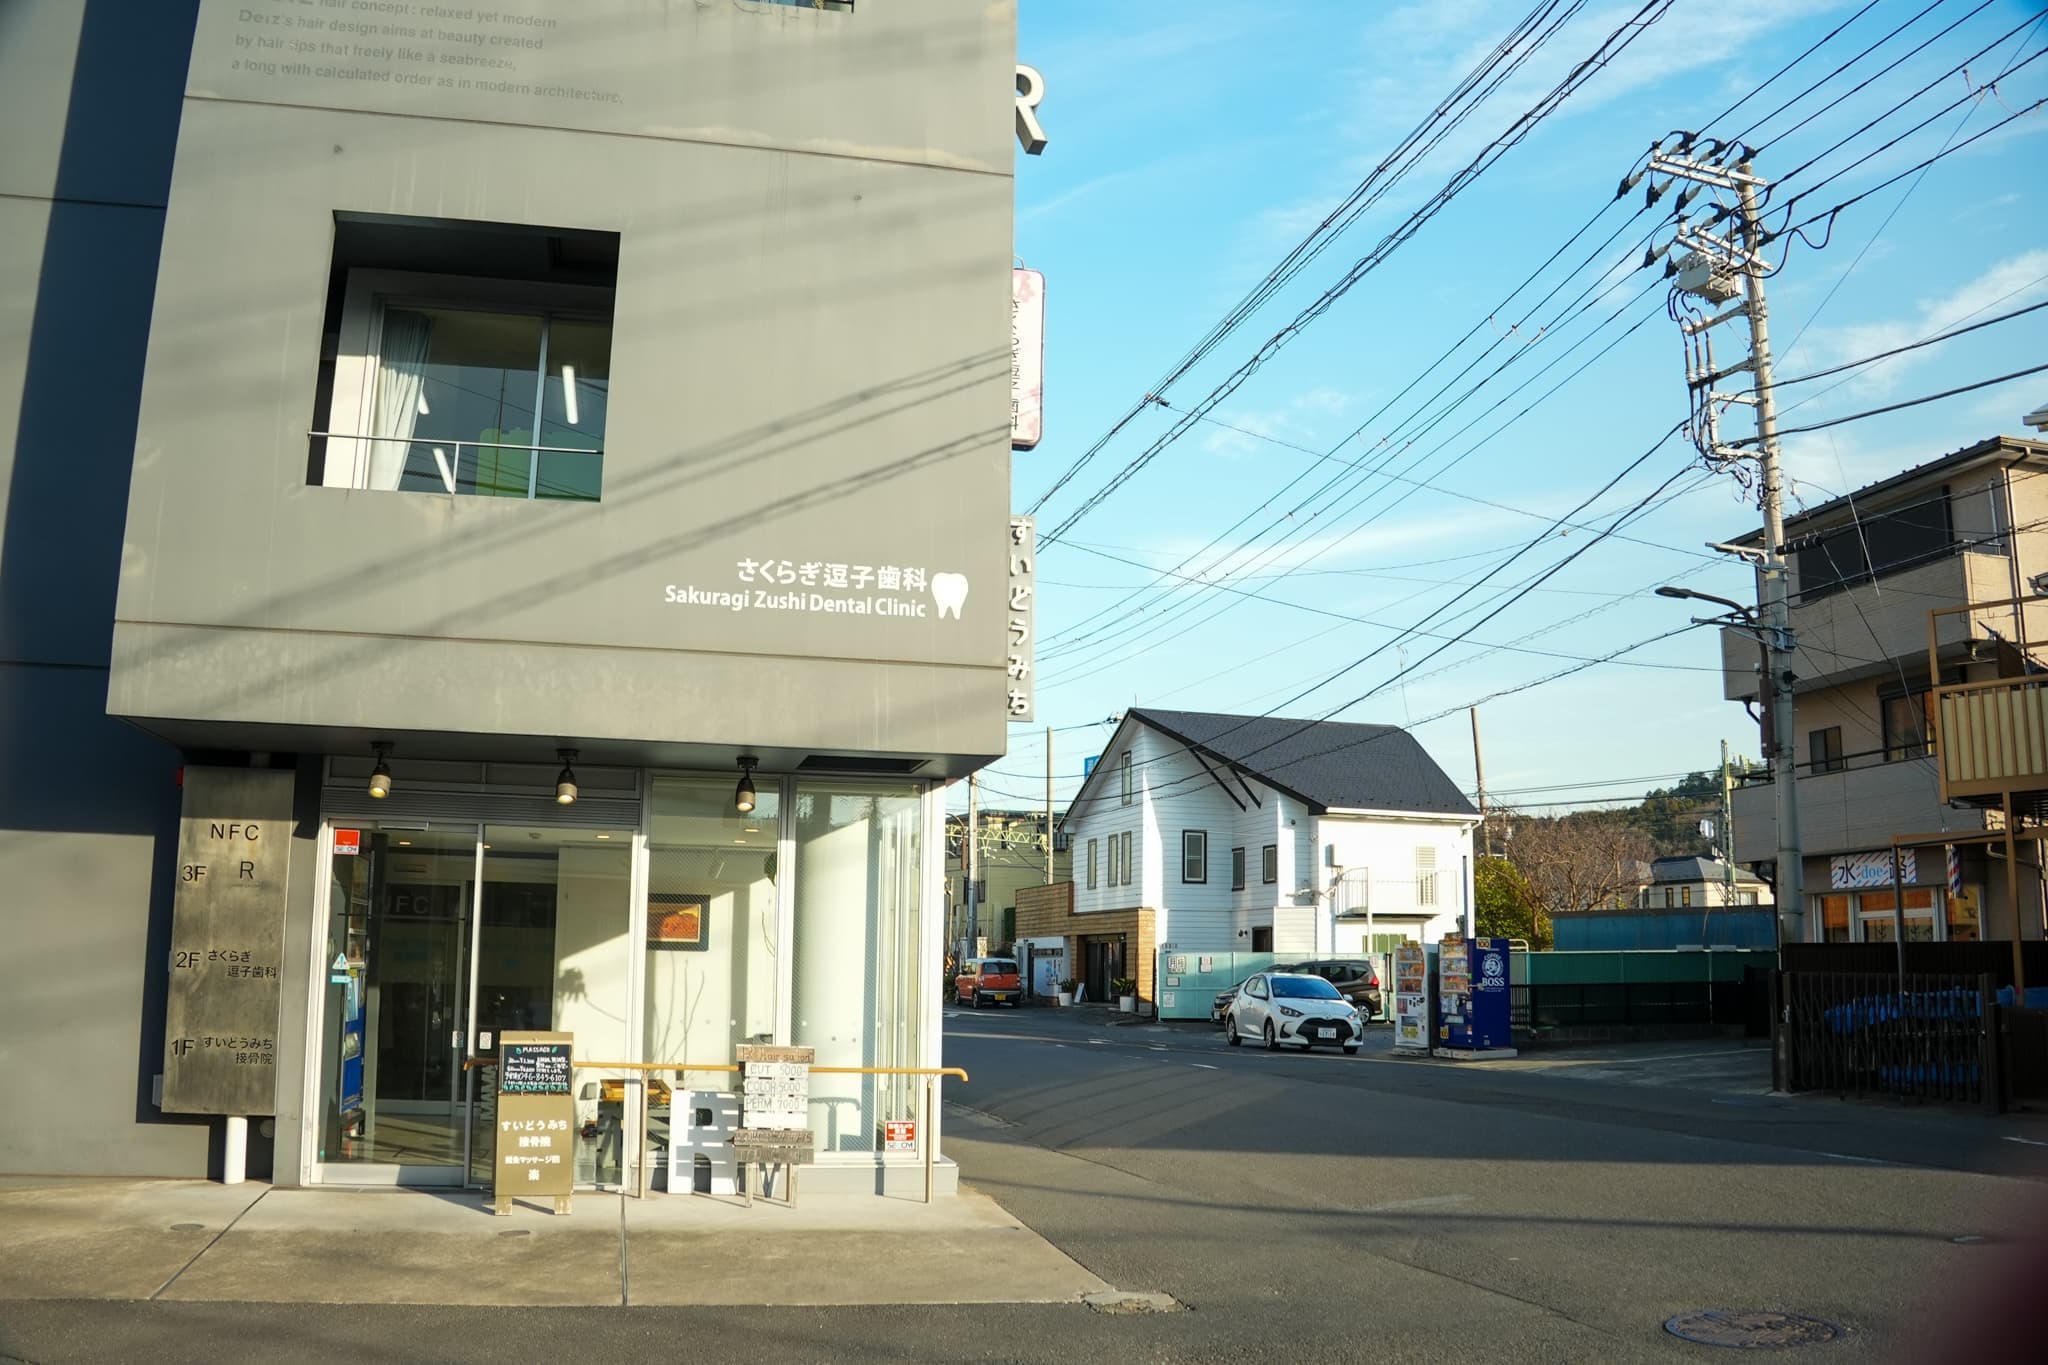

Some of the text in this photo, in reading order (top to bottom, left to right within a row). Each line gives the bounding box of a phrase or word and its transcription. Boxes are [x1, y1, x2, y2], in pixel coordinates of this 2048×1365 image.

[420, 5, 473, 20] relaxed
[477, 10, 498, 24] yet
[502, 13, 557, 29] modern
[297, 16, 324, 29] hair
[328, 19, 378, 36] design
[381, 24, 416, 38] aims
[420, 28, 434, 39] at
[438, 30, 486, 47] beauty
[489, 34, 544, 50] created
[235, 34, 253, 49] by
[257, 36, 285, 49] hair
[320, 42, 349, 56] that
[353, 44, 394, 61] freely
[398, 47, 423, 62] like
[427, 54, 435, 63] a
[231, 58, 624, 104] a long with calculated order as in modern architecture.
[736, 557, 928, 593] さくらぎ逗子歯科
[664, 584, 926, 617] Sakuragi Zushi Dental Clinic
[1007, 518, 1033, 715] すいどうみち
[210, 823, 260, 841] NFC
[182, 860, 255, 882] 3F R
[1838, 859, 1856, 884] 水
[1861, 865, 1883, 879] doe
[176, 950, 252, 968] 2F さくらぎ
[227, 965, 277, 979] 逗子歯科
[1481, 977, 1505, 987] BOSS
[171, 1036, 272, 1055] 1F すいどうみち
[235, 1052, 272, 1065] 接骨院
[501, 1119, 568, 1131] すいどうみち
